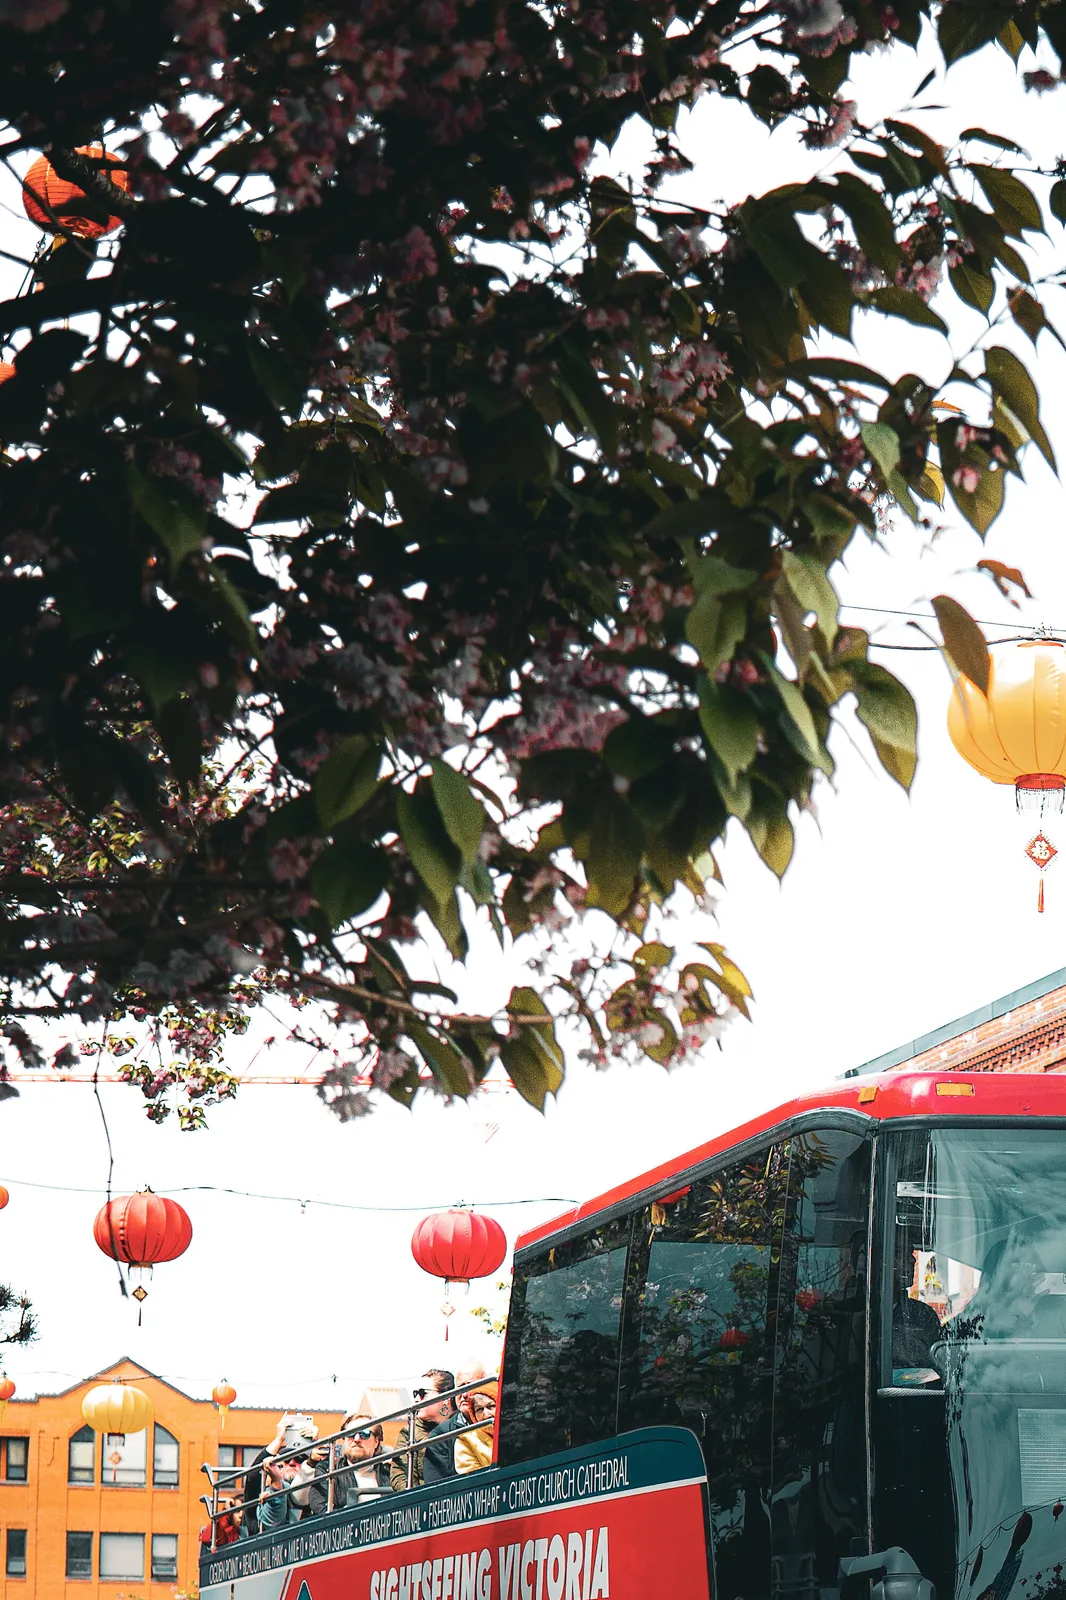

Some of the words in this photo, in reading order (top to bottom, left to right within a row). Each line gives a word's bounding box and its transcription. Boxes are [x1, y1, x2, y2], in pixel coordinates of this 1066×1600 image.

[209, 1563, 225, 1585] OGDEN
[226, 1556, 239, 1581] POINT
[242, 1551, 260, 1576] BEACON
[261, 1548, 272, 1572] HILL
[272, 1546, 283, 1569] PARK
[288, 1541, 300, 1564] MILE
[309, 1530, 332, 1556] BASTION
[332, 1523, 354, 1551] SQUARE
[359, 1513, 391, 1544] STEAMSHIP
[391, 1506, 422, 1536] TERMINAL
[428, 1493, 473, 1528] FISHERMAN'S
[474, 1485, 500, 1516] WHARF
[509, 1476, 537, 1510] CHRIST
[538, 1468, 576, 1504] CHURCH
[577, 1455, 630, 1496] CATHEDRAL
